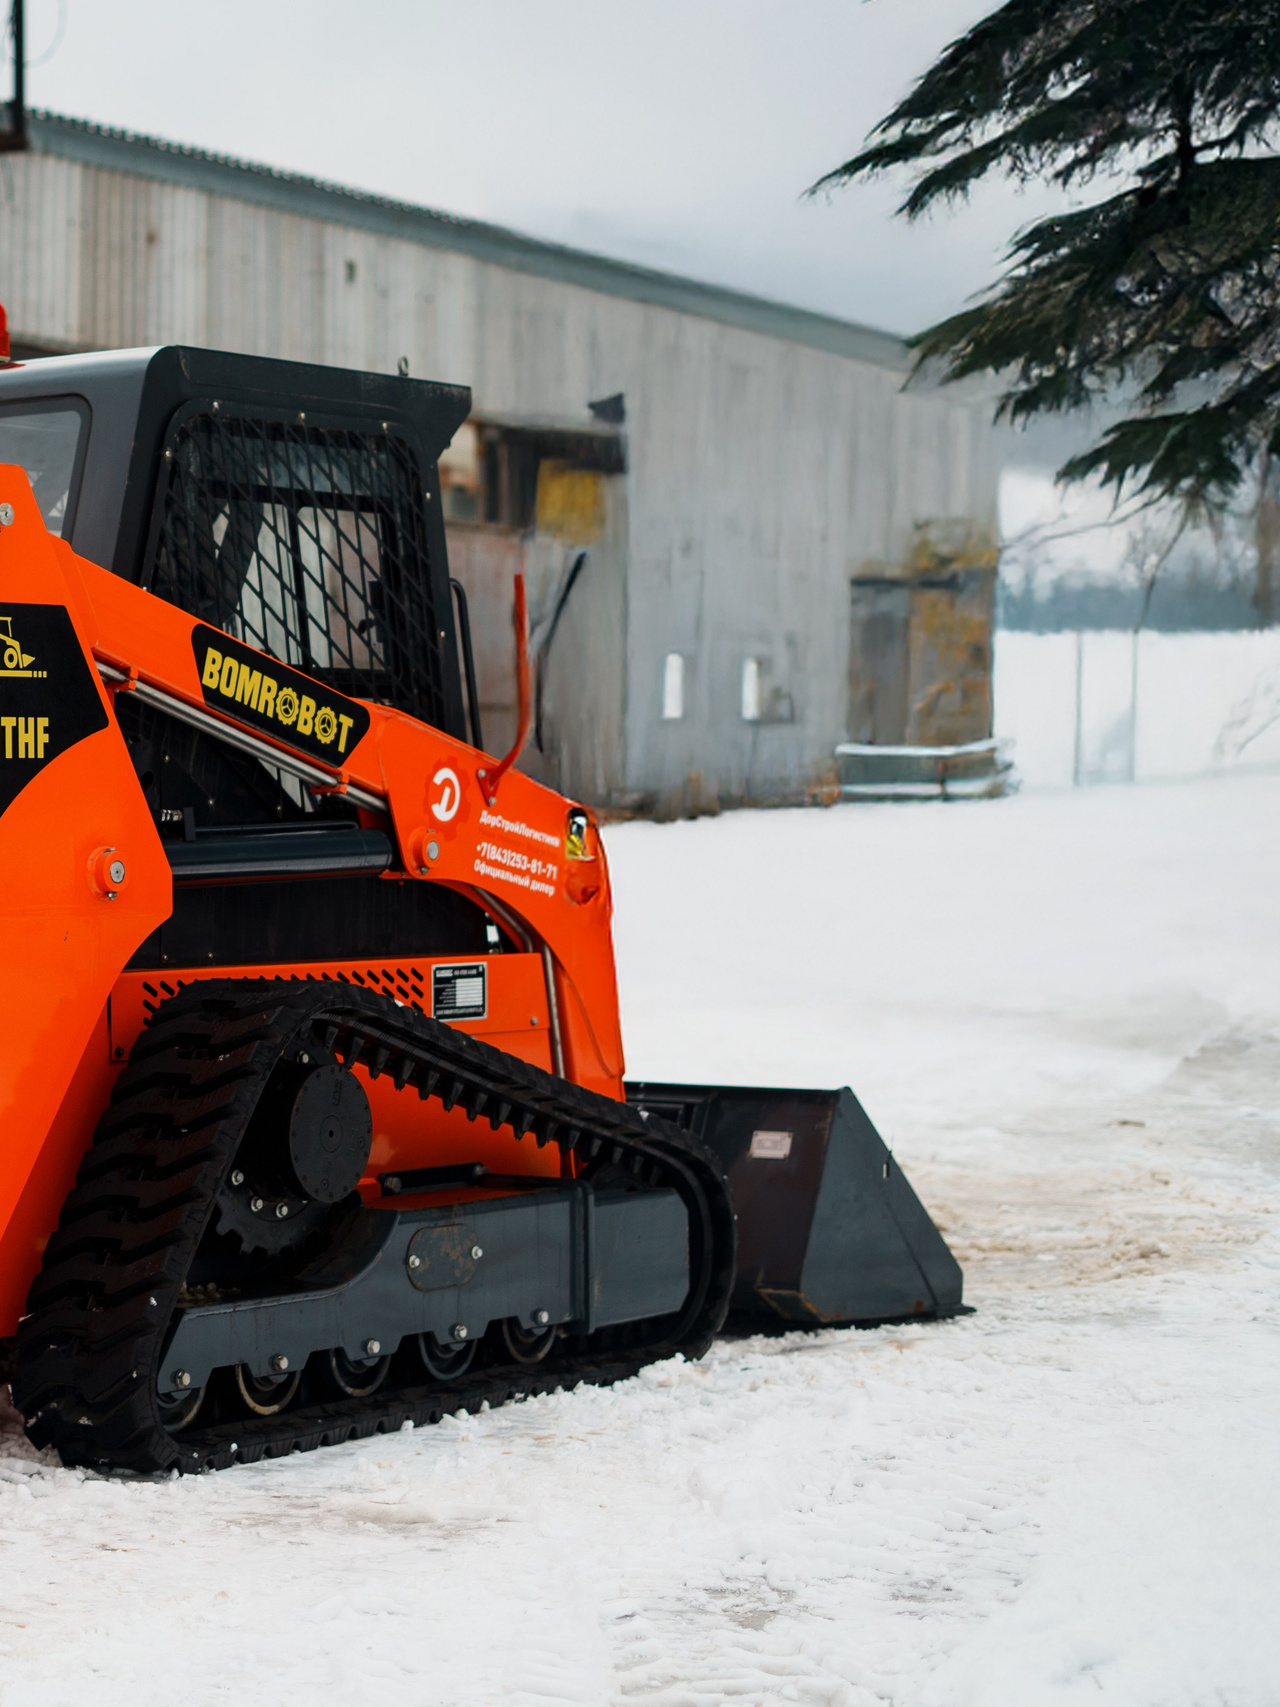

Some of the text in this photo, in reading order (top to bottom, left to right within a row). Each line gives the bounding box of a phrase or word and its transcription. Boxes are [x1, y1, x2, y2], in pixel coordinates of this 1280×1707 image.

[201, 646, 354, 753] BOMROBOT
[479, 810, 560, 847] ДорСтройЛогистика
[474, 859, 555, 897] Официальный дилер
[476, 842, 557, 880] +7(843)253-81-71
